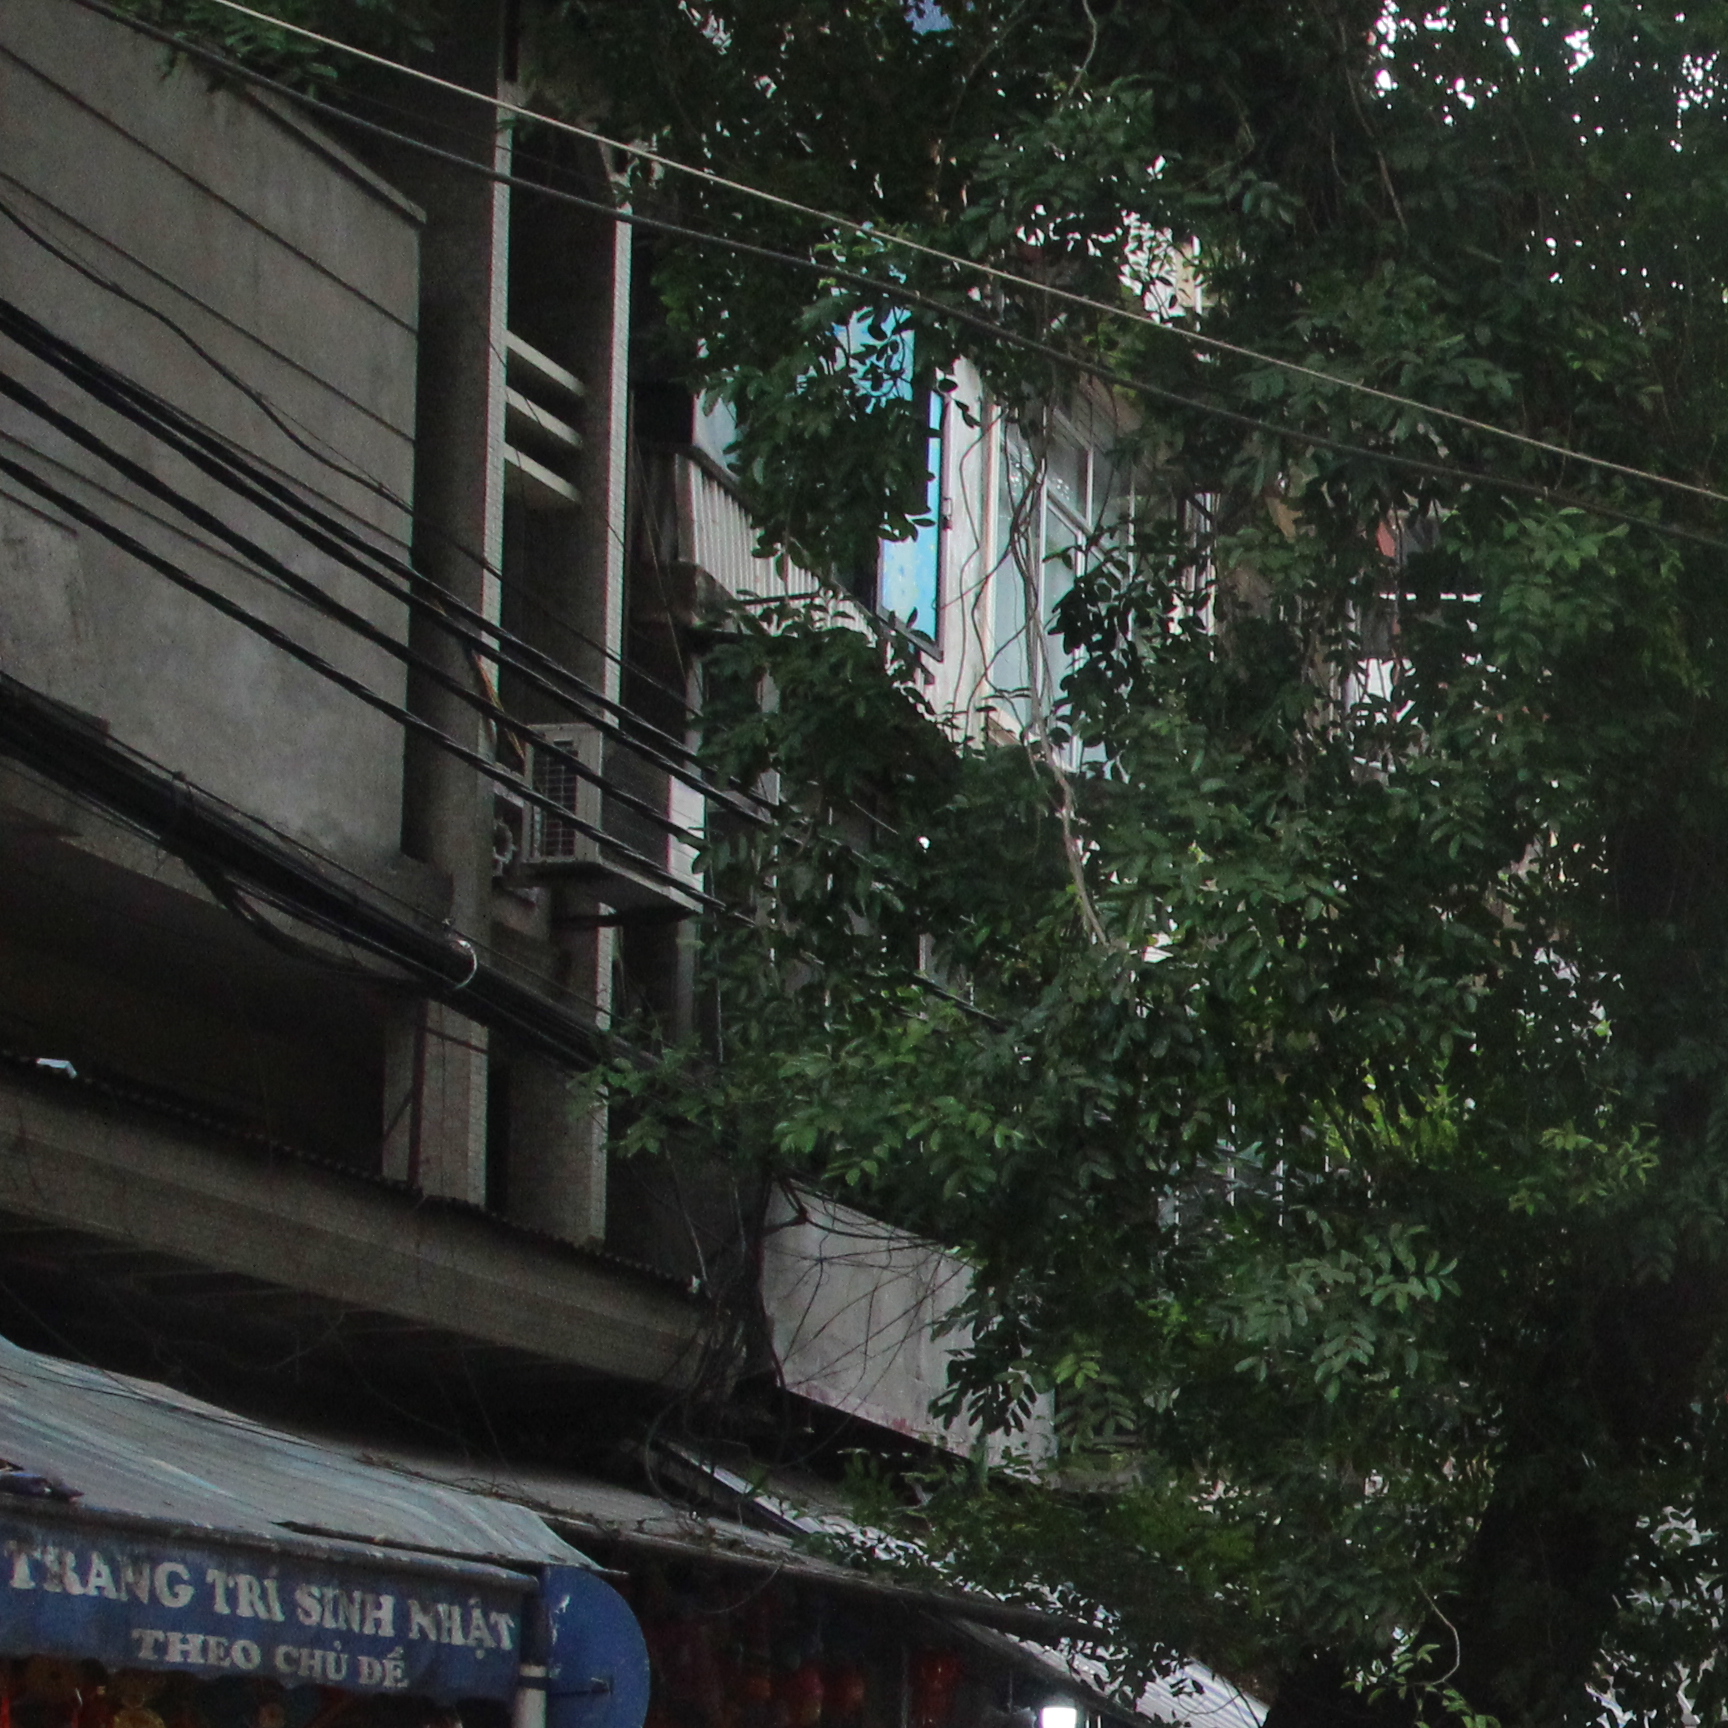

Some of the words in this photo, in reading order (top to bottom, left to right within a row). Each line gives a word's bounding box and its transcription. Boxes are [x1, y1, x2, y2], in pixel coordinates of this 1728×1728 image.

[4, 1542, 195, 1608] TRANG
[296, 1584, 396, 1638] SINH
[408, 1598, 516, 1660] NHẬT
[132, 1628, 260, 1671] THEO
[275, 1641, 349, 1682] CHỦ
